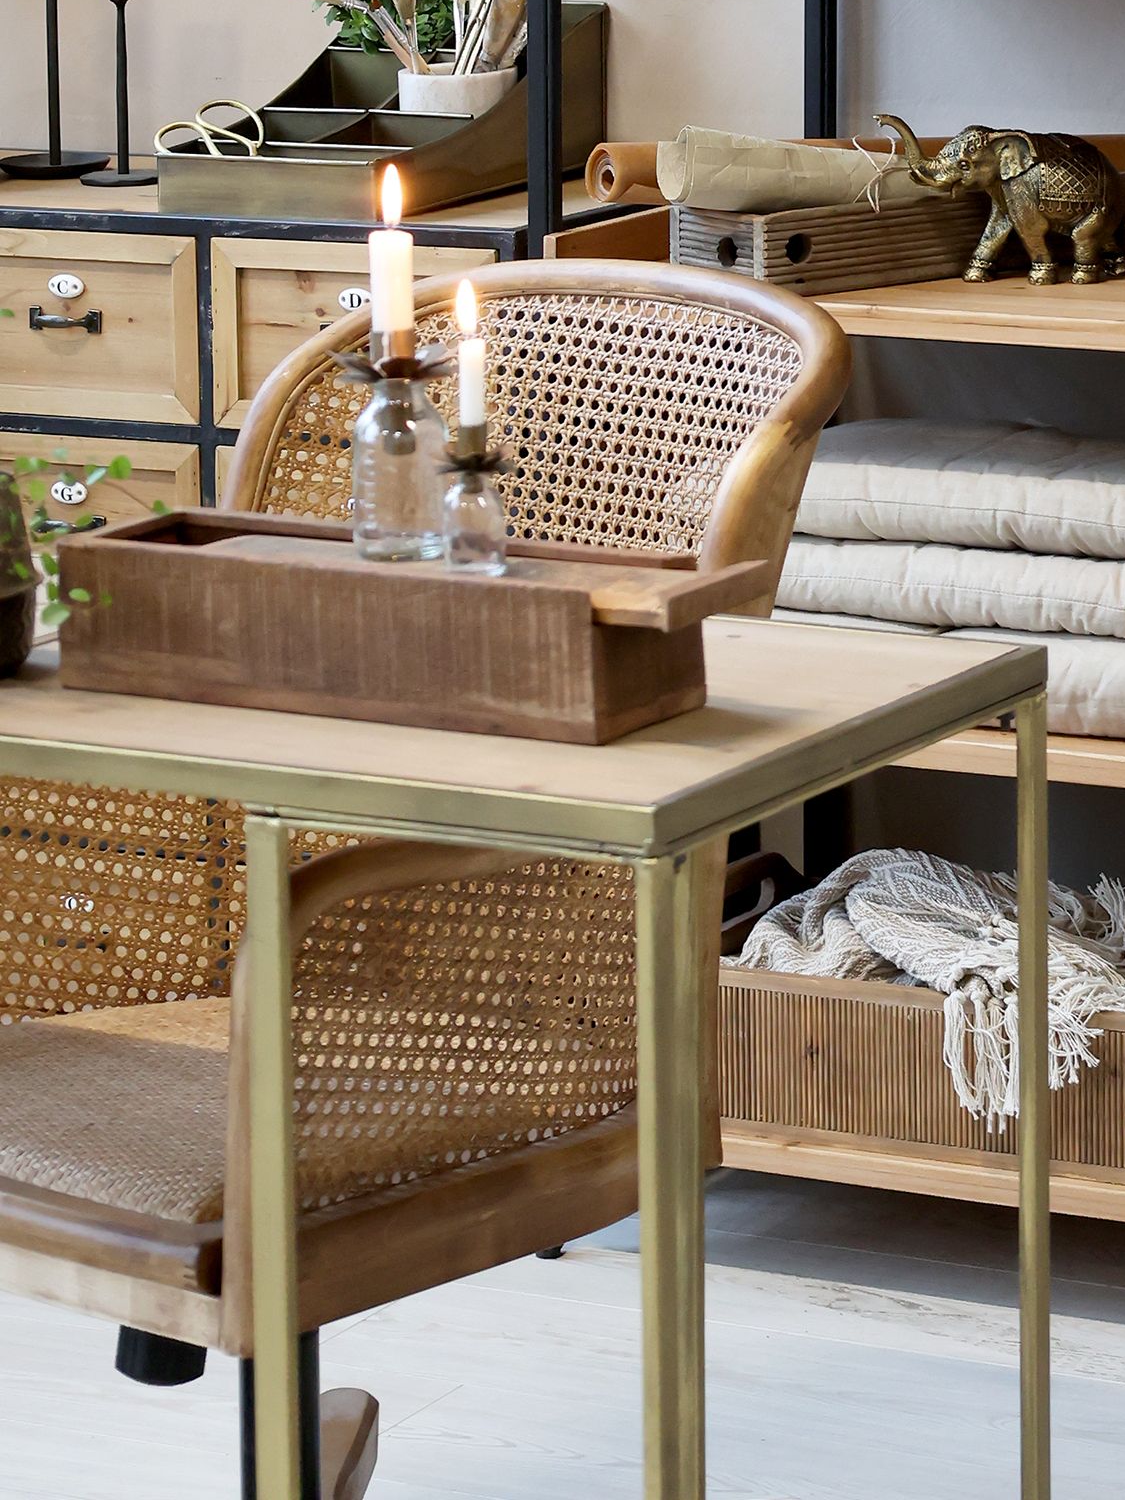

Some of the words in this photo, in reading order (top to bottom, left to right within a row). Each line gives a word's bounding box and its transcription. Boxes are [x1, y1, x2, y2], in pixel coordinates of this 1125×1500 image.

[56, 280, 69, 294] C
[349, 293, 362, 308] D
[60, 487, 73, 502] G
